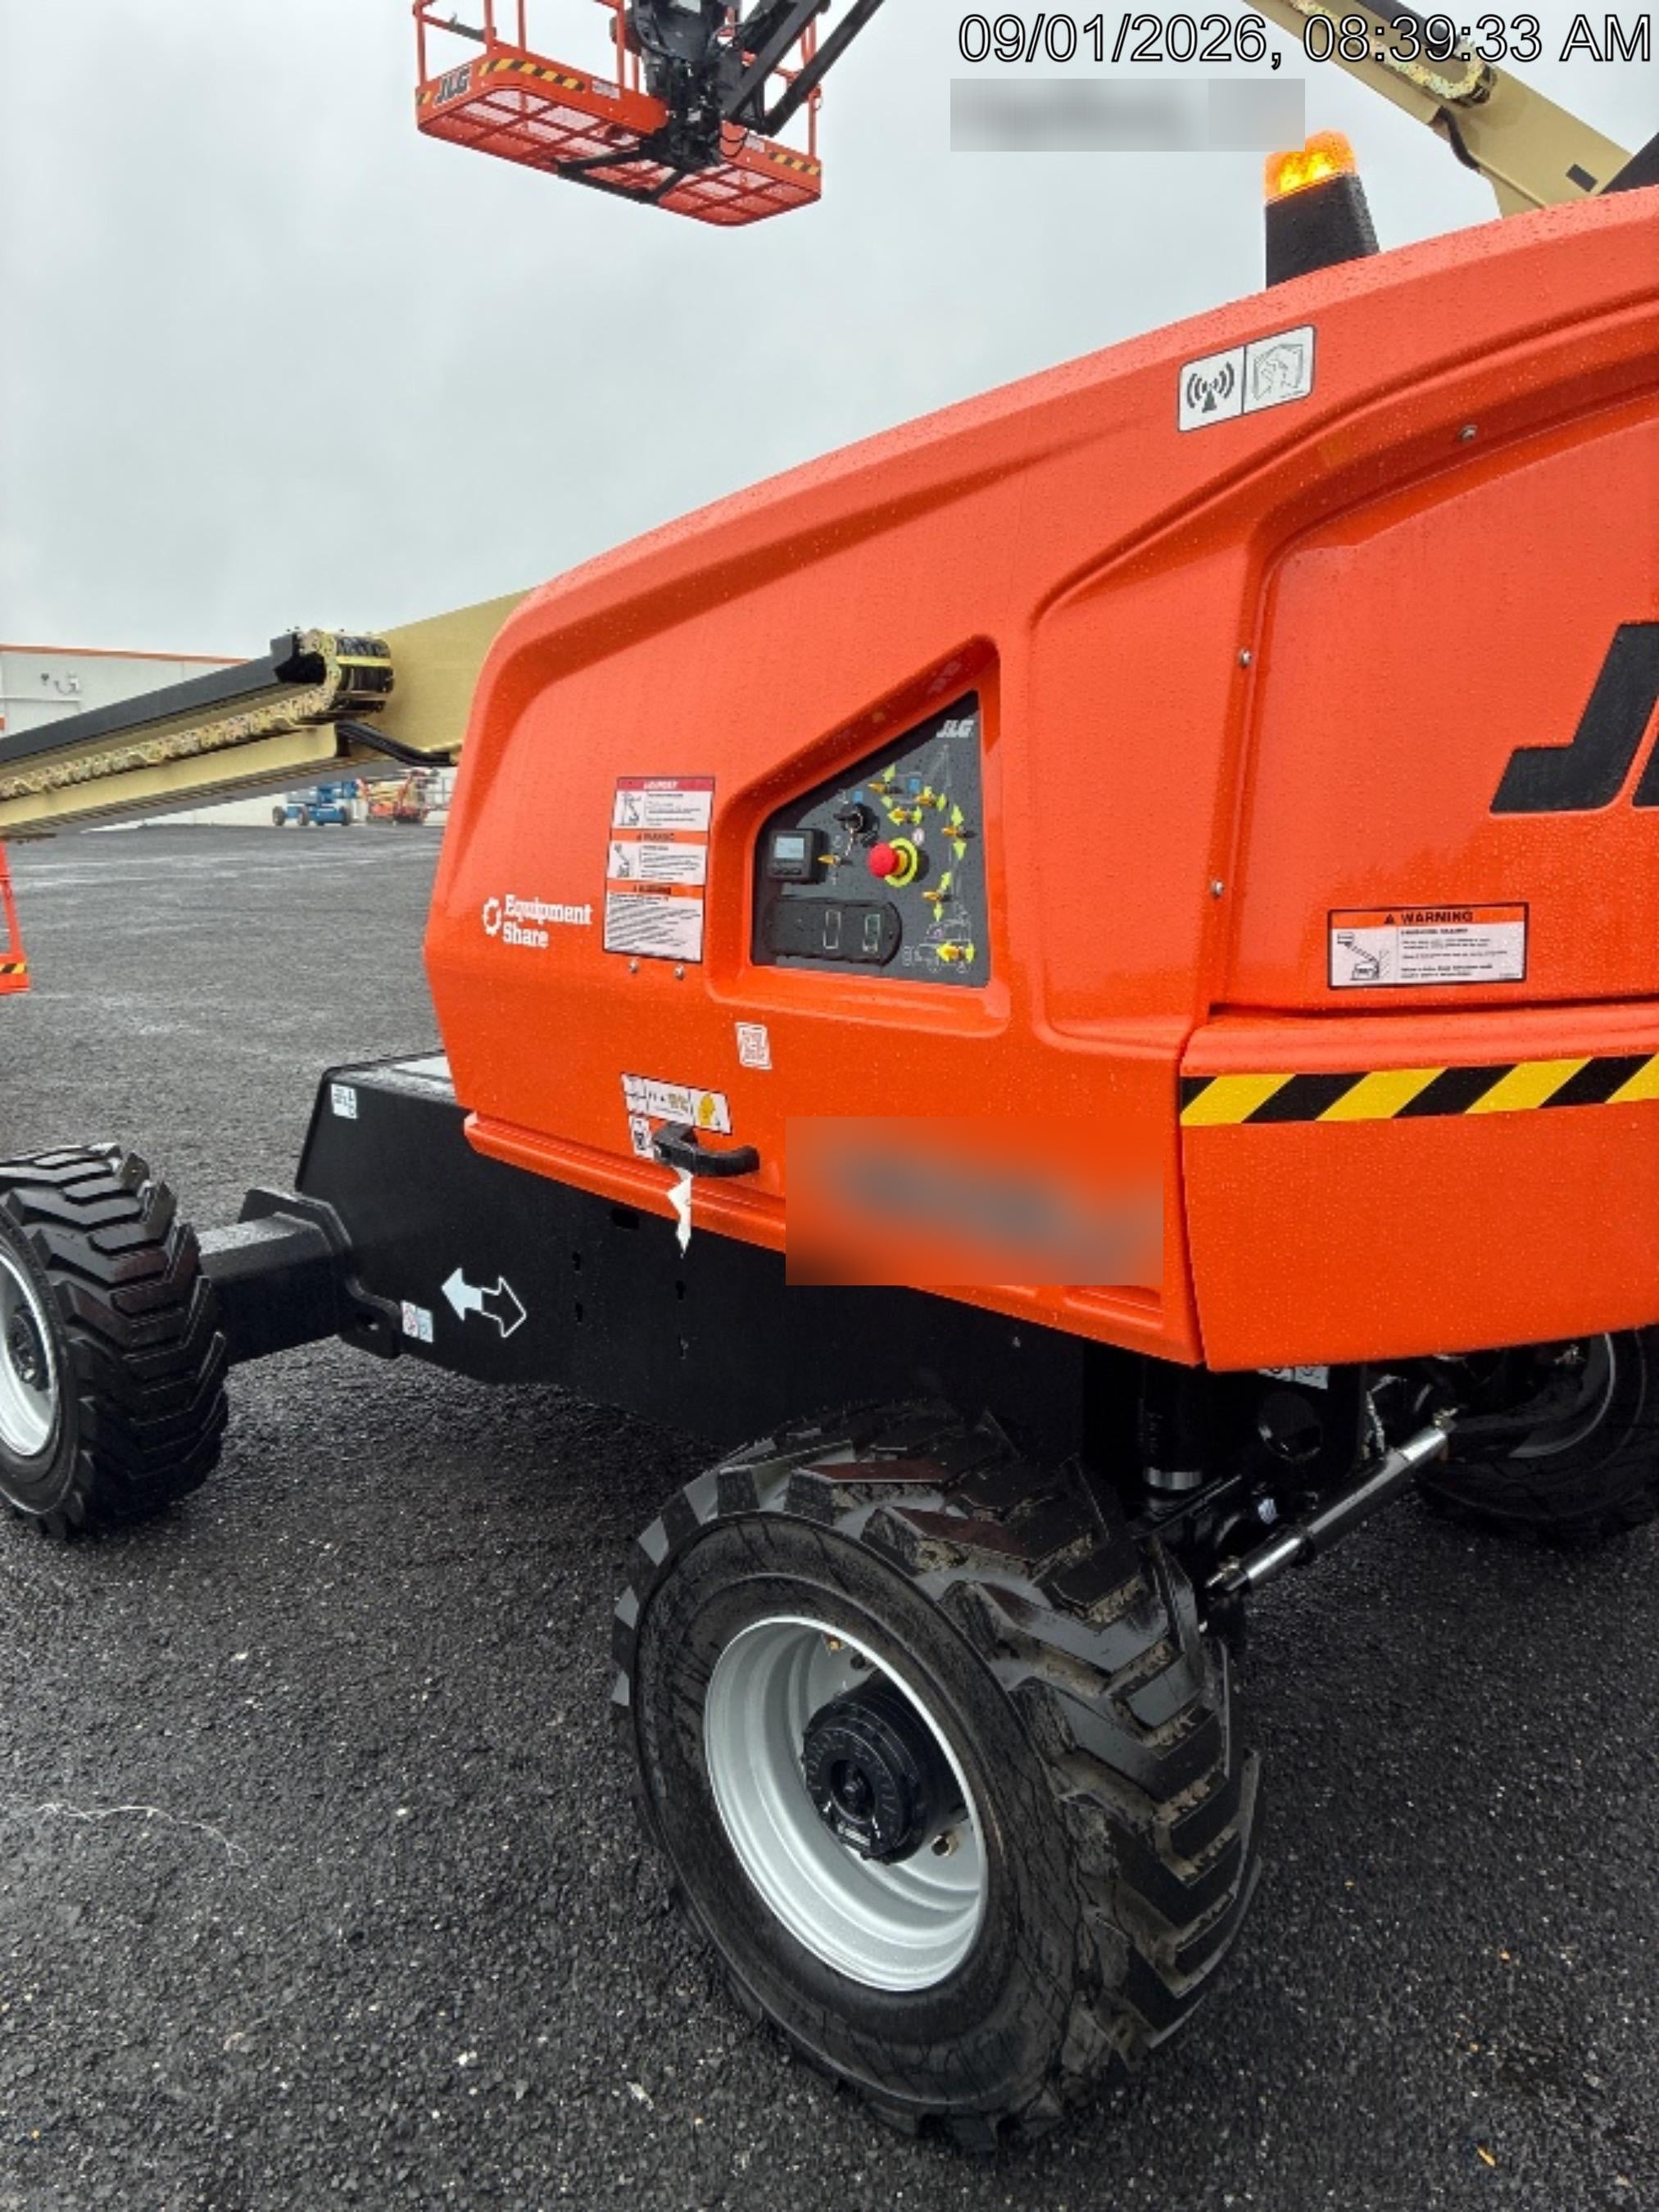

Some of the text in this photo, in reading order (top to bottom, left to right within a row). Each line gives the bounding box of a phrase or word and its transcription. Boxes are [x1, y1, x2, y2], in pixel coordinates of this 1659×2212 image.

[1489, 623, 1659, 813] J
[505, 894, 592, 926] Equipment
[1401, 910, 1473, 924] WARNING
[503, 921, 548, 948] Share
